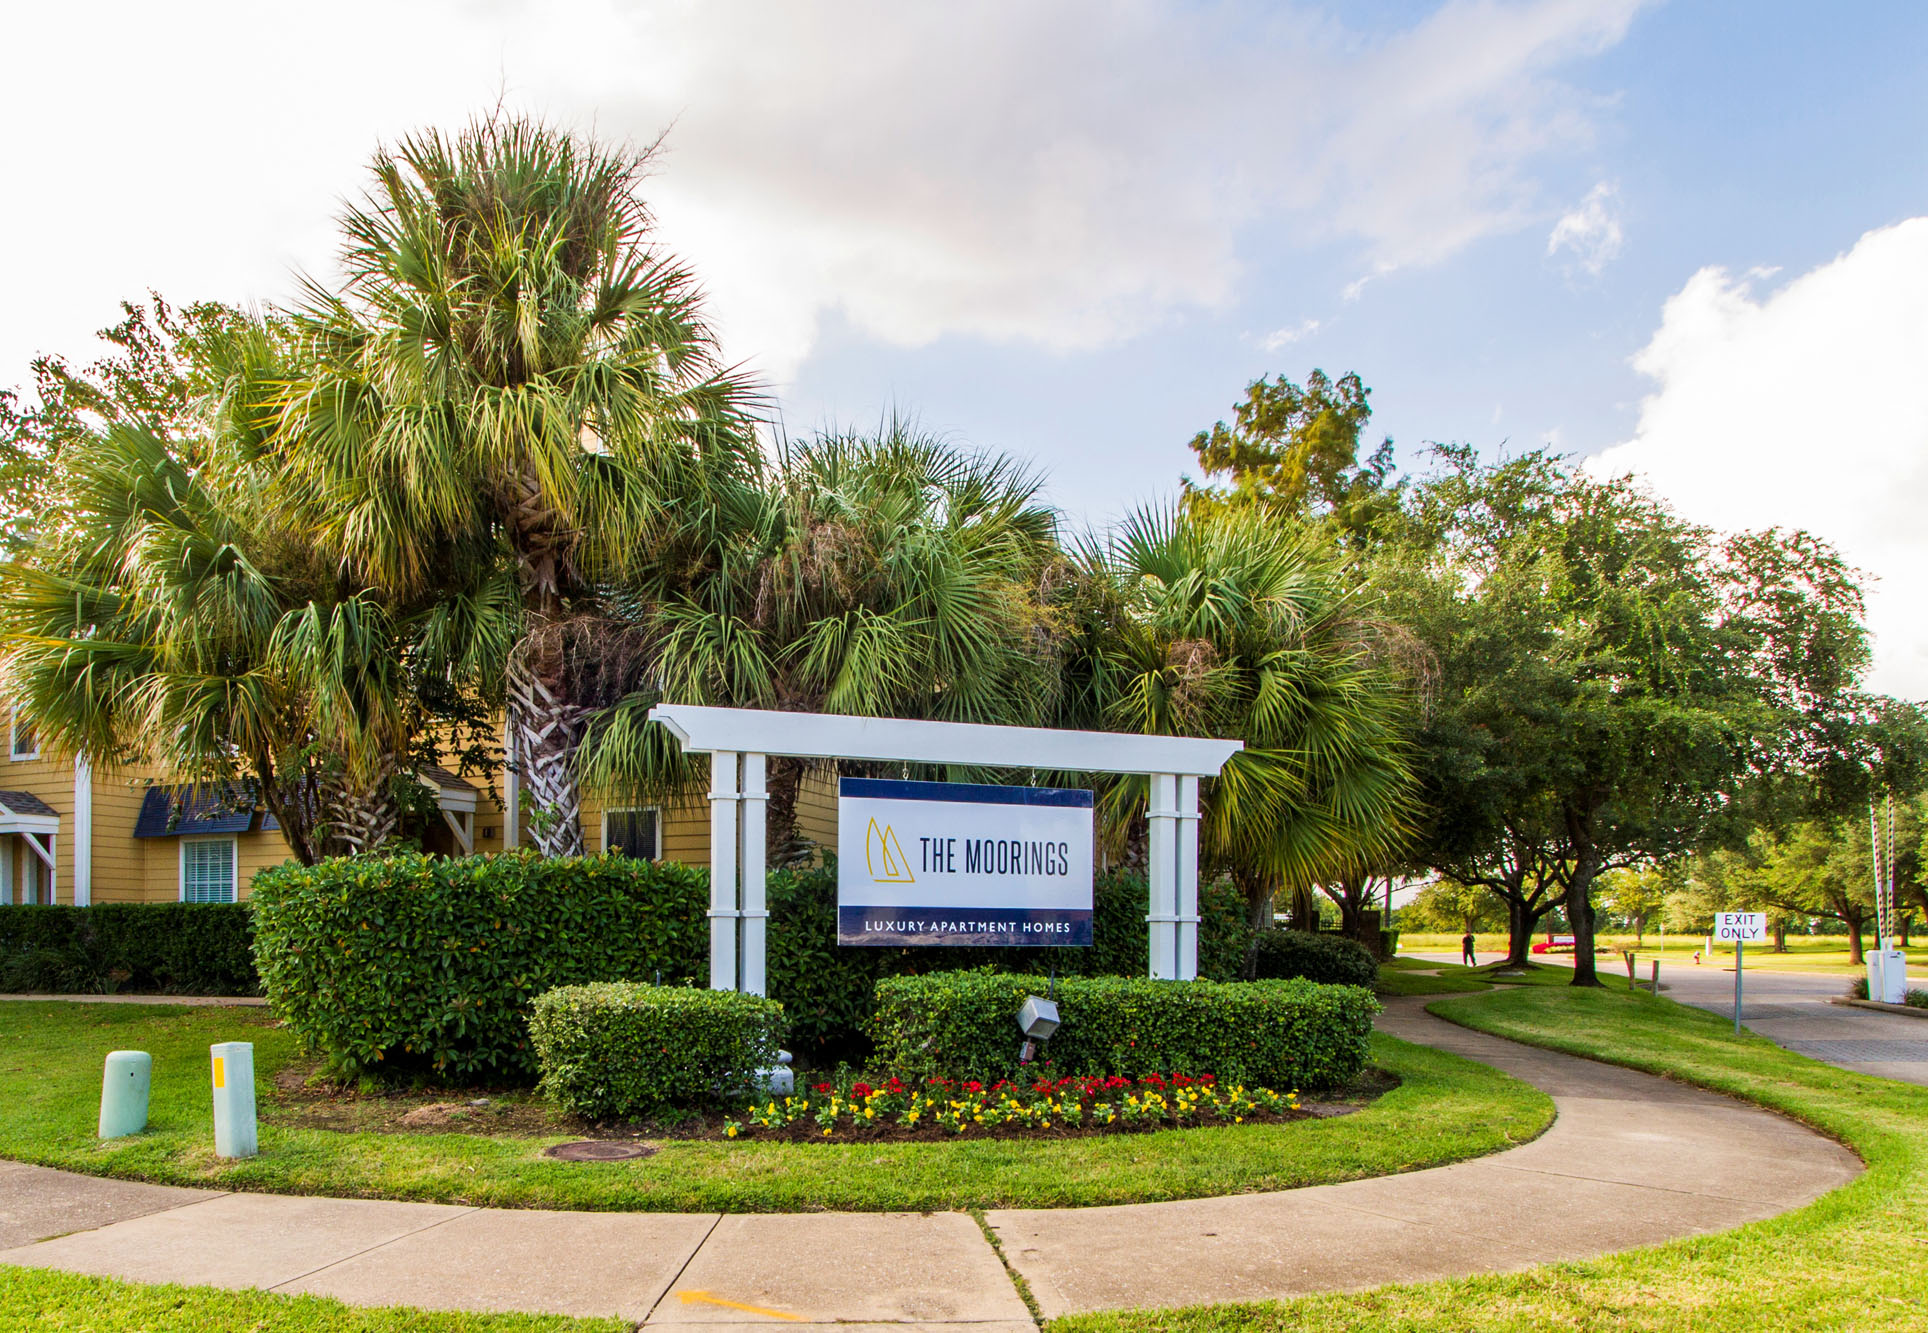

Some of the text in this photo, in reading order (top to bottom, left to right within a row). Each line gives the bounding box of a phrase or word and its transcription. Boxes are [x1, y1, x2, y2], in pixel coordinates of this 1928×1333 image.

[919, 837, 1069, 876] THE MOORINGS
[1724, 914, 1756, 925] EXIT
[865, 920, 1071, 934] LUXURY APARTMENT HOMES
[1720, 927, 1759, 939] ONLY
